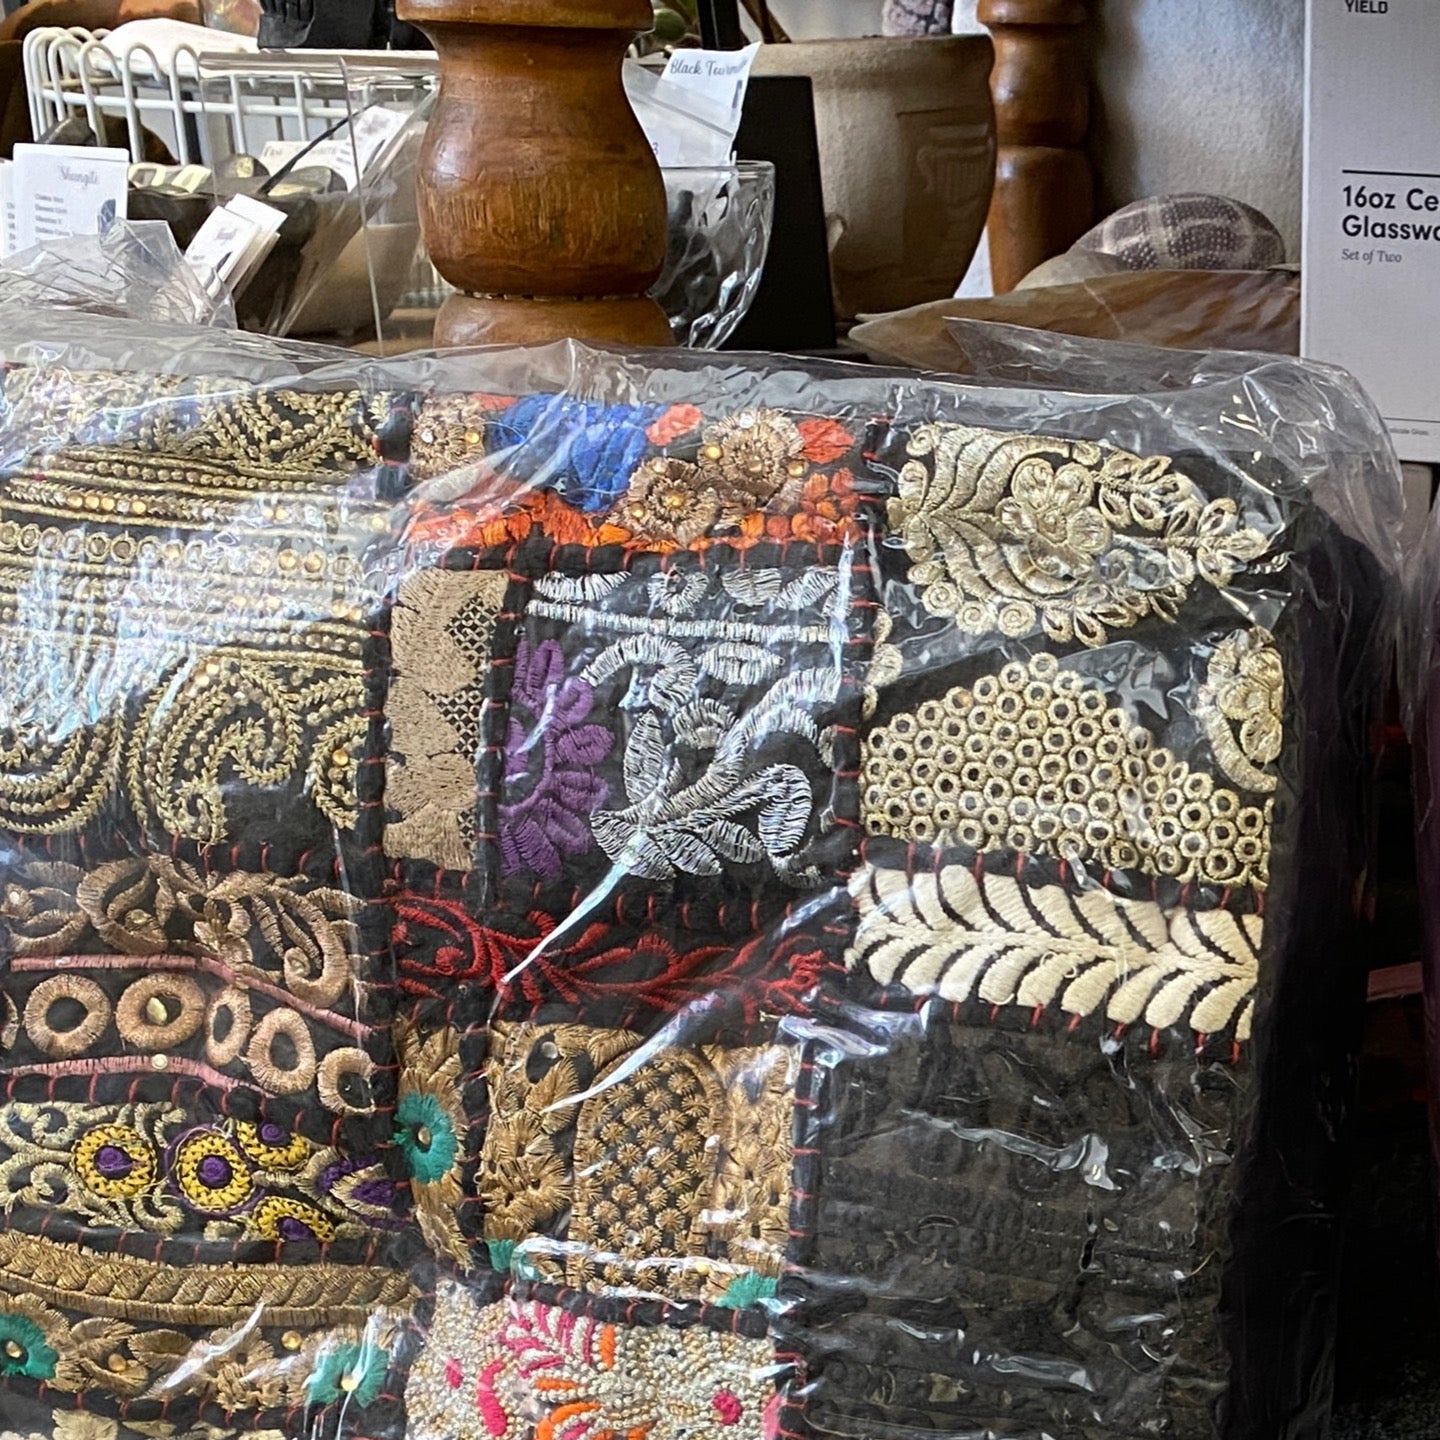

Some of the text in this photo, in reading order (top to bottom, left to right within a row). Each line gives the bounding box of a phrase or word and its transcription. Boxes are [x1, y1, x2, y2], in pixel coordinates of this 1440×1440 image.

[1344, 0, 1388, 14] YIELD
[669, 57, 702, 75] Black
[1342, 185, 1397, 210] 16oz
[1341, 248, 1402, 265] Set of Two
